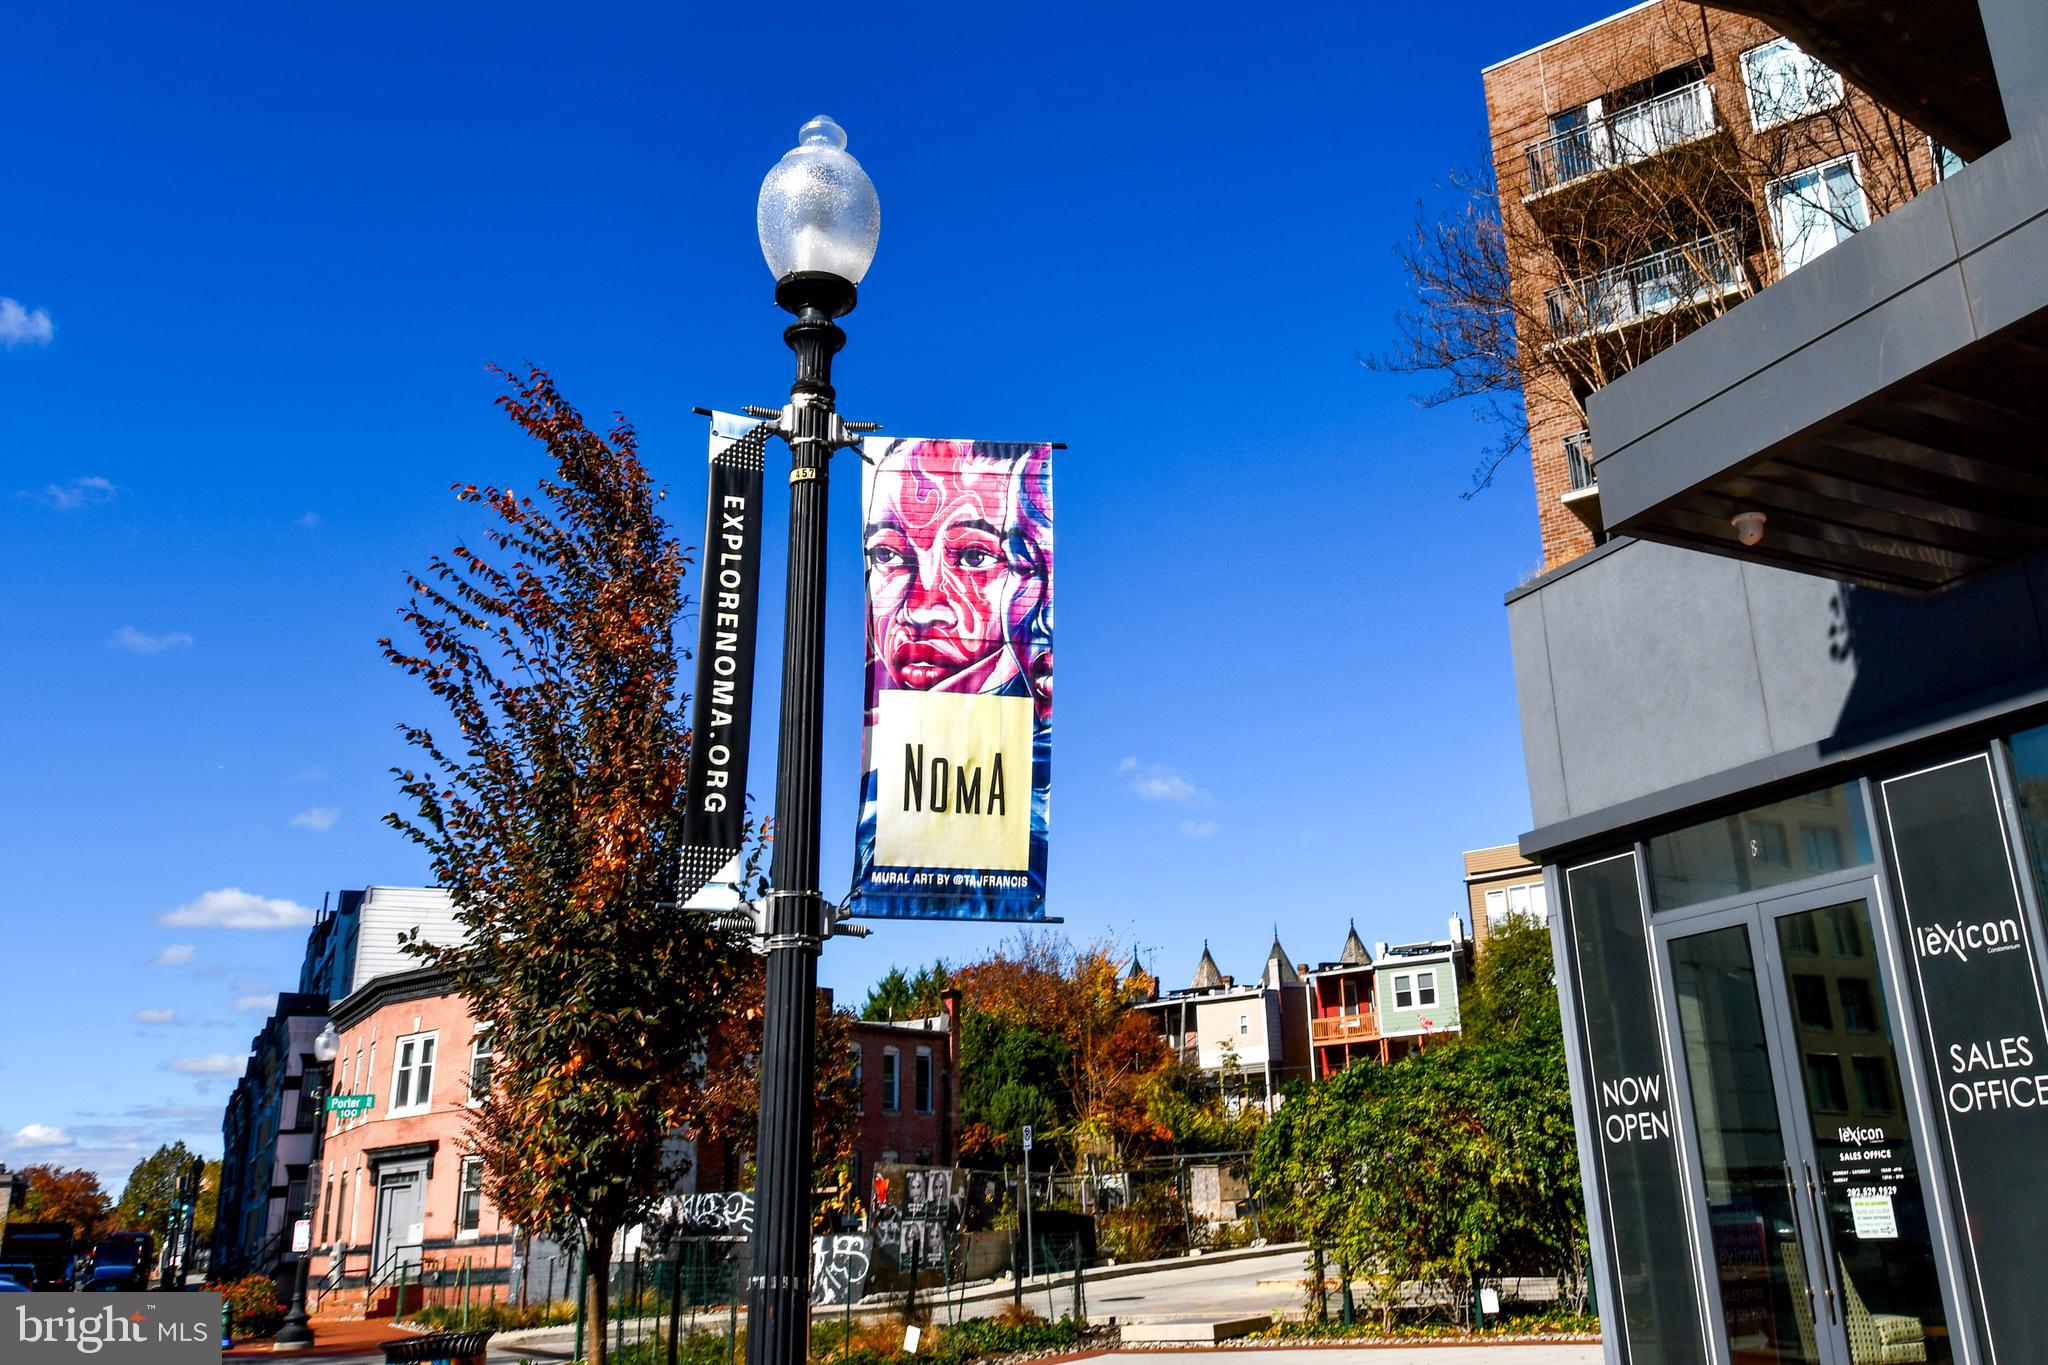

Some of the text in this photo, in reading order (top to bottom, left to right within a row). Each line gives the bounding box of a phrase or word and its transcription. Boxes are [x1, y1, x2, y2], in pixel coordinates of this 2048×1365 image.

[795, 468, 815, 479] 457
[704, 495, 745, 813] EXPLORENOMA.ORG
[871, 872, 1028, 888] MURAL ART BY @TAJFRANCIS
[1917, 919, 2019, 962] lexicon
[1987, 943, 2021, 954] Condominium
[1949, 1035, 2034, 1074] SALES
[1602, 1074, 1660, 1108] NOW
[1949, 1074, 2048, 1113] OFFICE
[331, 1098, 361, 1109] Porter
[341, 1109, 358, 1118] 100
[1605, 1110, 1670, 1143] OPEN
[1838, 1126, 1884, 1147] lexicon
[1839, 1149, 1892, 1162] SALES OFFICE
